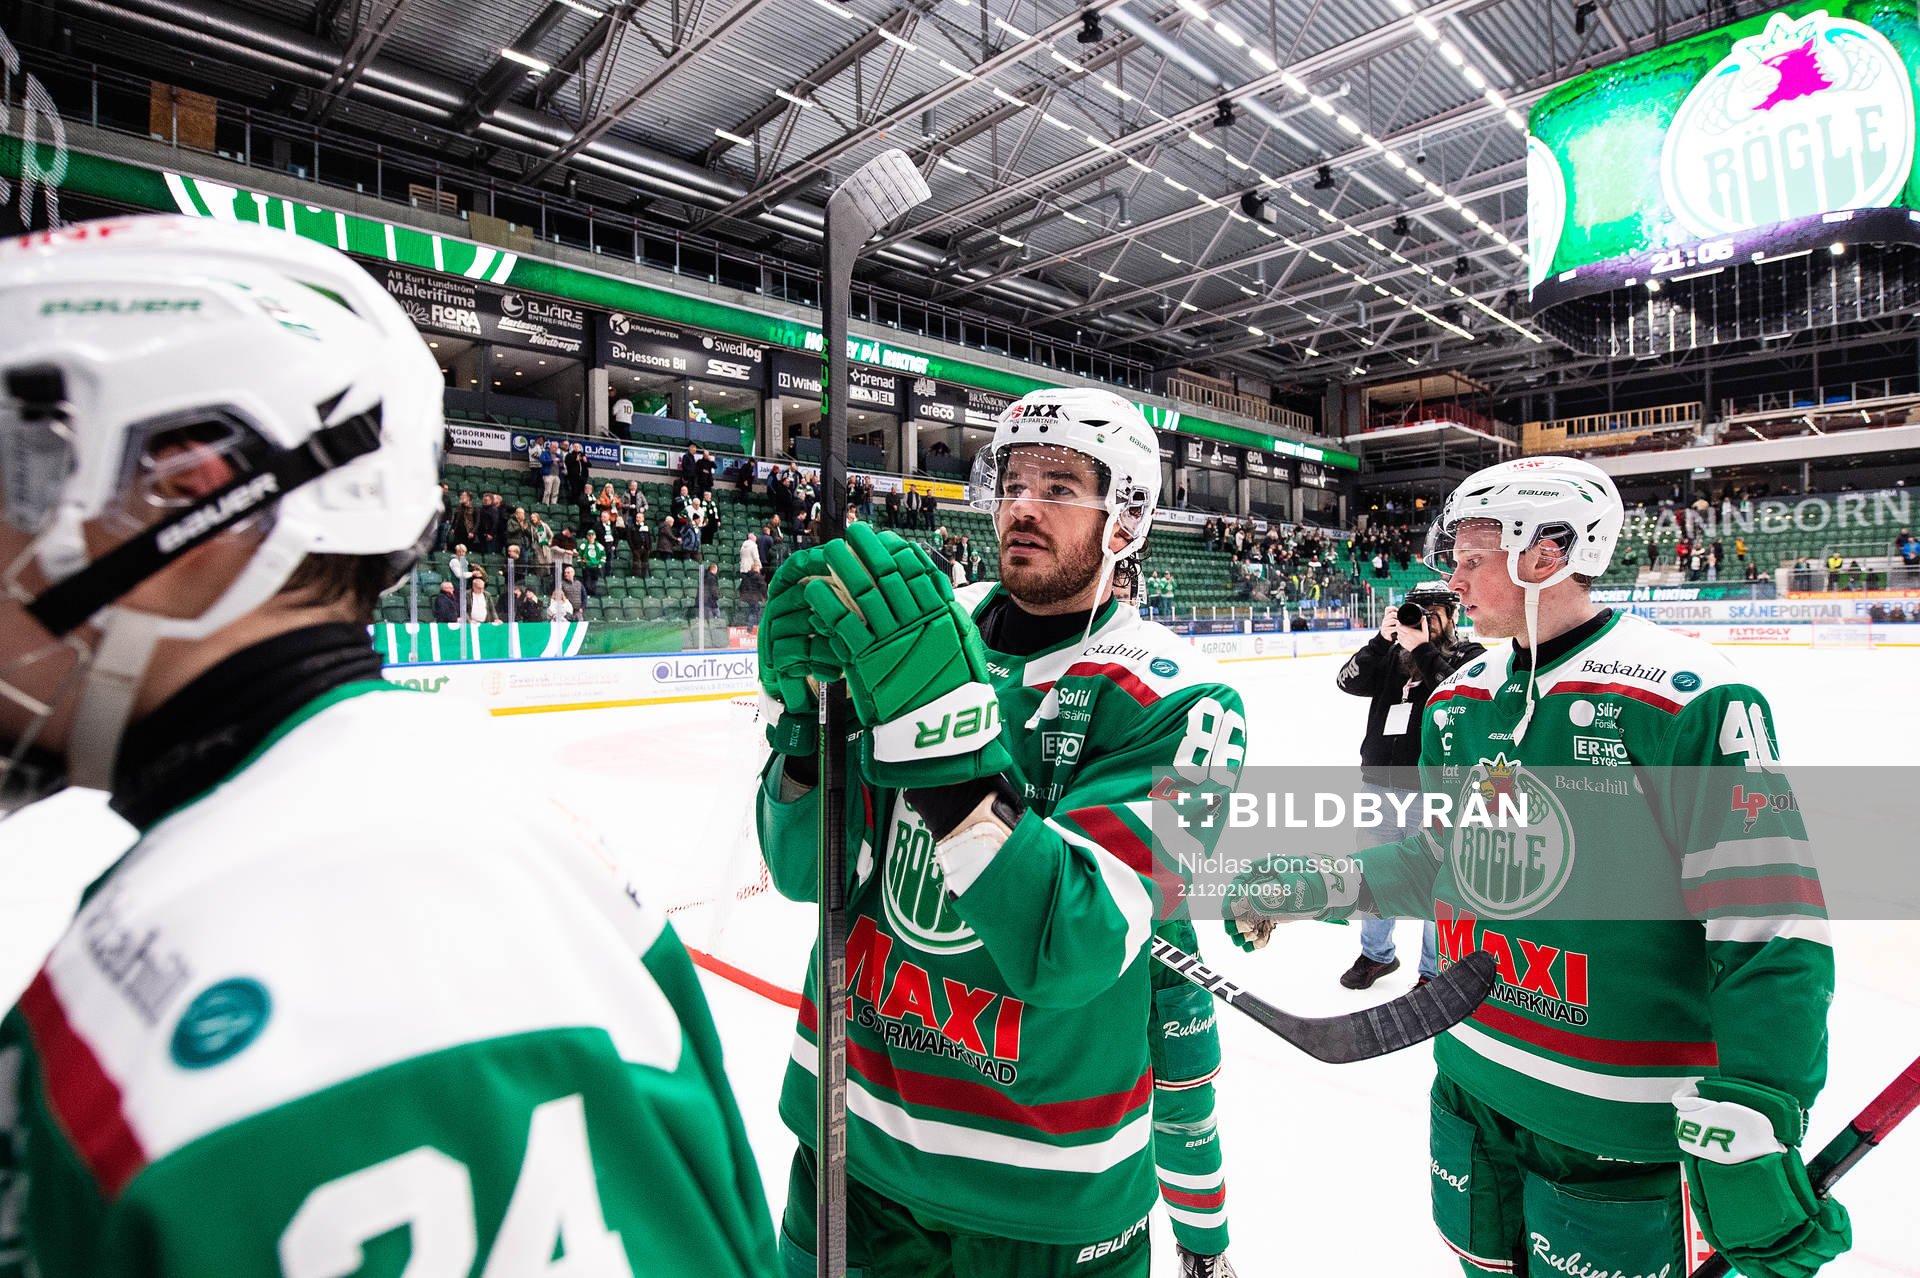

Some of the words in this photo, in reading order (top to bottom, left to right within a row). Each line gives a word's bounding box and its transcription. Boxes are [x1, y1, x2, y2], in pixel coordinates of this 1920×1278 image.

[1703, 105, 1887, 230] RÖGLE
[387, 280, 475, 308] Målerifirma
[405, 273, 425, 284] Kurt
[428, 278, 475, 294] Lundström
[527, 314, 583, 330] ENTREPRENAD
[528, 302, 583, 324] BJÄRE
[630, 325, 679, 339] KRANPUNKTEN
[715, 341, 762, 363] swedlog
[673, 358, 686, 370] Bil
[706, 359, 751, 380] SSE
[792, 376, 822, 393] Wihlb
[920, 404, 955, 420] areco
[1023, 404, 1062, 419] IXX
[1518, 489, 1559, 497] BAUER
[155, 472, 280, 554] BAUER
[1729, 603, 1843, 618] SKÅNEPORTAR
[1729, 627, 1791, 636] FLYTGOLV
[675, 657, 753, 680] LariTryck
[1580, 659, 1667, 684] Backahill
[914, 700, 1003, 749] UER
[1172, 696, 1246, 792] 86
[1578, 740, 1628, 759] ER-HO
[1592, 756, 1618, 767] BYGG
[1555, 775, 1629, 796] Backahill
[1434, 898, 1588, 1008] MAXI
[846, 914, 1025, 1062] MAXI
[1488, 982, 1589, 1027] MARKNAD
[831, 957, 847, 1164] RIBCOR
[1675, 1115, 1736, 1153] ER
[278, 1093, 636, 1278] 24
